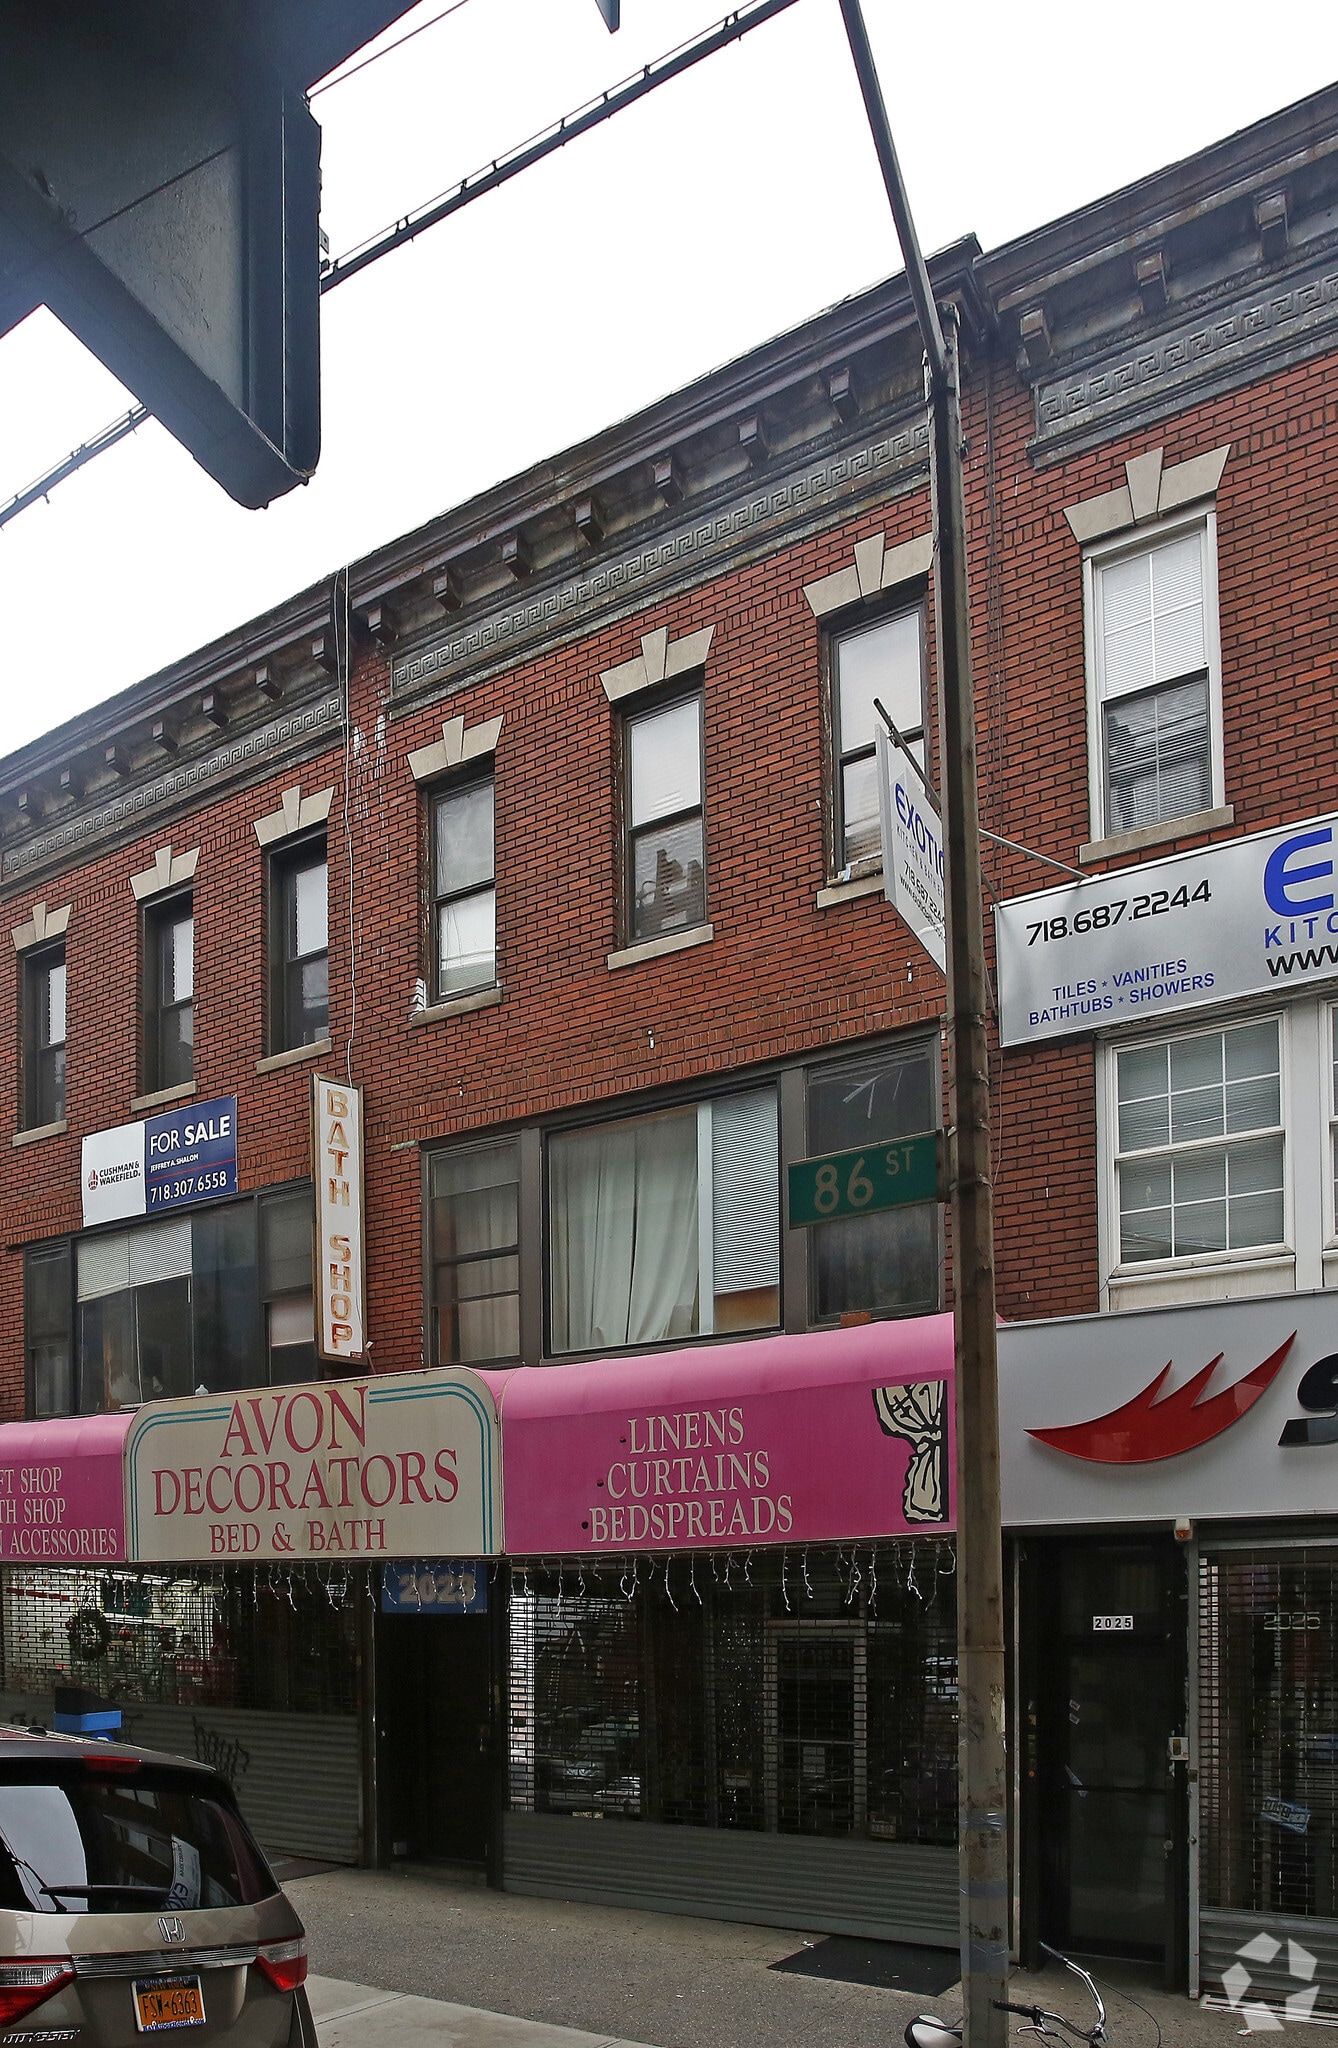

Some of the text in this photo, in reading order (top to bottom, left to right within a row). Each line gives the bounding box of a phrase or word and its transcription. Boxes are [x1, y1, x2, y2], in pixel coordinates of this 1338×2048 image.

[1263, 827, 1334, 918] E
[1026, 879, 1212, 947] 718.687.2244
[1029, 973, 1215, 1026] BATHTUBS SHOWERS
[1052, 959, 1187, 1001] TILES VANITIES
[150, 1115, 231, 1156] FOR SALE
[99, 1163, 134, 1178] CUSHMAN
[150, 1160, 170, 1174] JEFFREY
[175, 1153, 199, 1166] SHALOM
[814, 1146, 915, 1214] 86 ST
[150, 1171, 227, 1204] 718.307.6558
[327, 1089, 353, 1349] BATH SHOP
[220, 1386, 369, 1458] AVON
[628, 1407, 745, 1455] LINENS
[20, 1466, 62, 1494] SHOP
[152, 1449, 459, 1516] DECORATORS
[607, 1450, 770, 1500] CURTAINS
[24, 1498, 66, 1525] SHOP
[589, 1494, 793, 1543] BEDSPREADS
[9, 1528, 117, 1556] ACCESSORIES
[209, 1518, 388, 1553] BED & BATH
[1094, 1617, 1132, 1629] 2025
[1263, 1612, 1320, 1630] 2025
[171, 1991, 197, 2015] 6363
